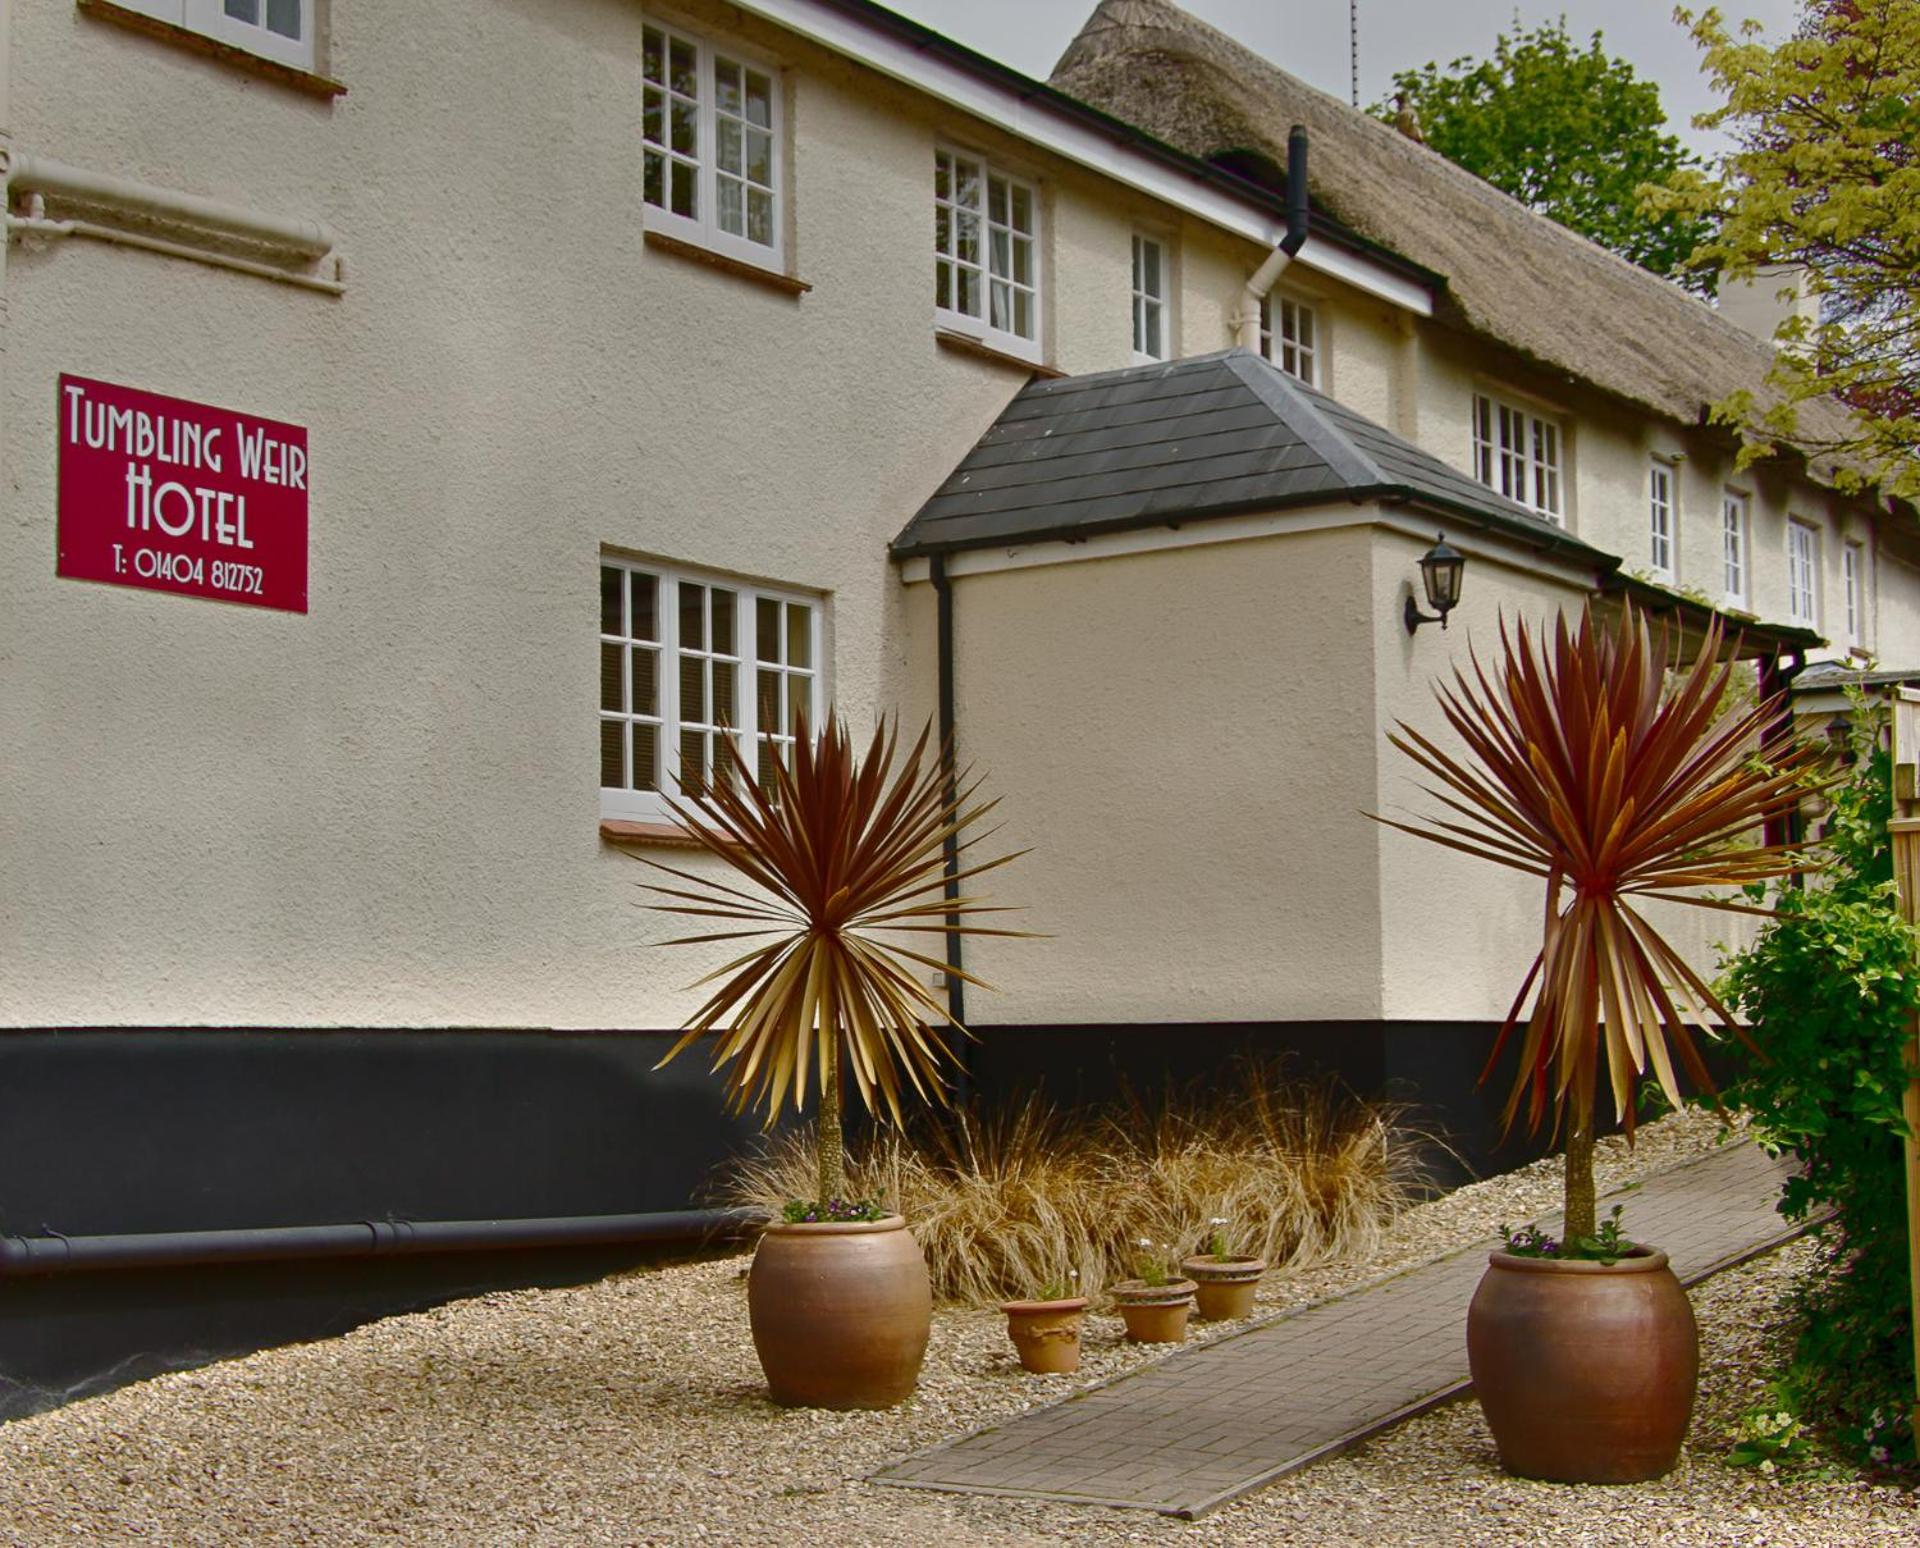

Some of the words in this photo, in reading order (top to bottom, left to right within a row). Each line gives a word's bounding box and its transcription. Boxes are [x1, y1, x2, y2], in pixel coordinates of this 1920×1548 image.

[65, 385, 222, 473] TUMBLING
[236, 422, 306, 490] WEIR
[126, 462, 254, 549] HOTEL
[112, 544, 127, 574] T:
[134, 549, 204, 585] 01404
[211, 560, 264, 595] 812752
